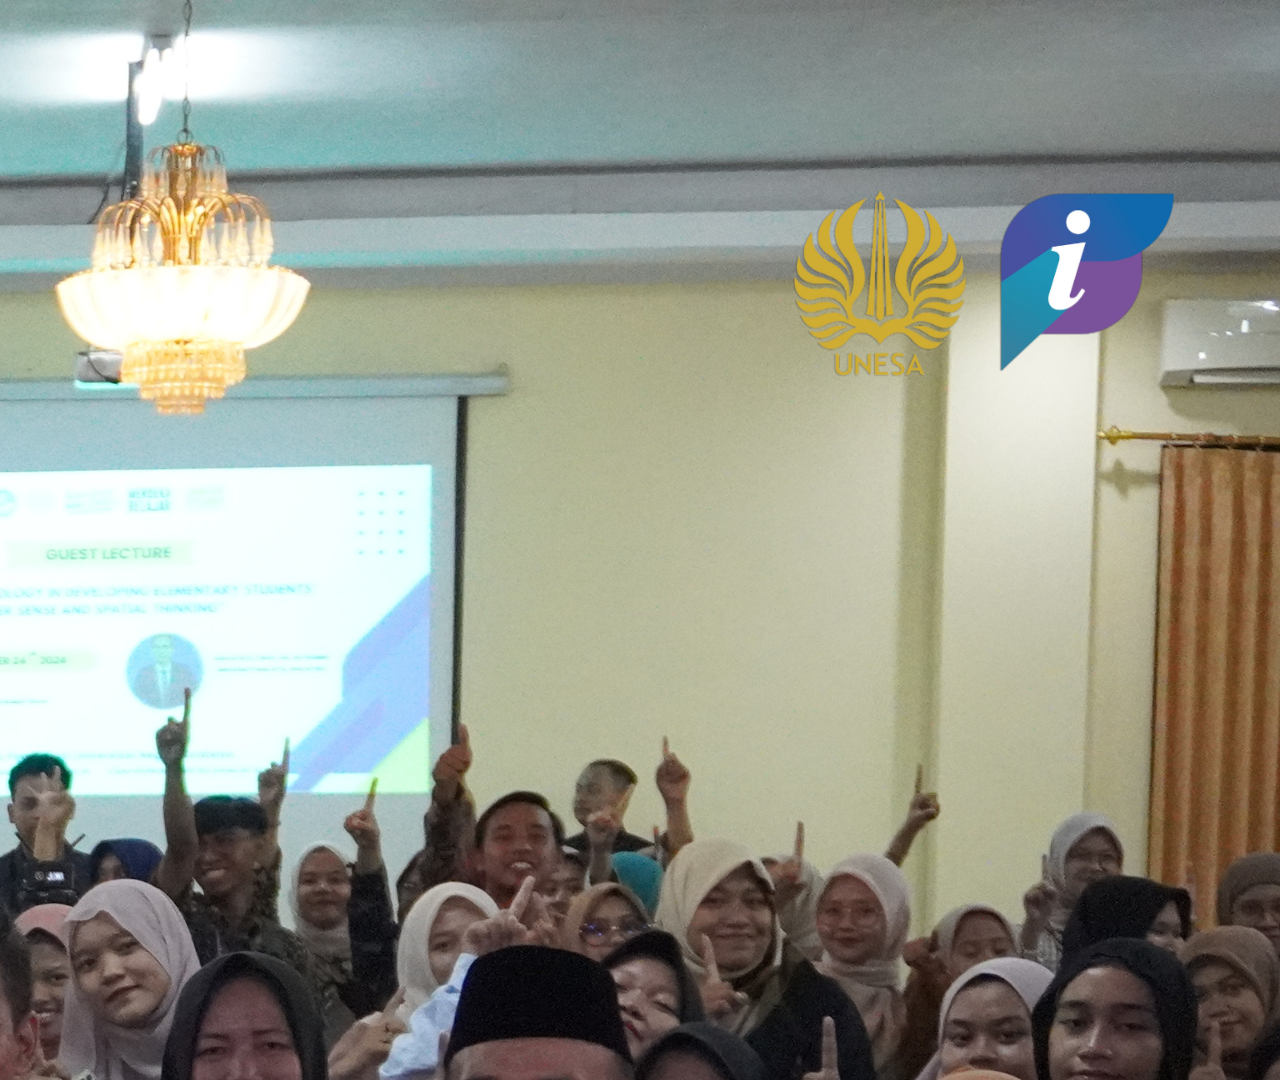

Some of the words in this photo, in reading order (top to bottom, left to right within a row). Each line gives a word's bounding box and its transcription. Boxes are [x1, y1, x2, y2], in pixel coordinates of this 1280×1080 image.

[46, 548, 98, 560] GUEST
[102, 547, 172, 560] LECTURE
[66, 585, 148, 598] DEVELOPING
[153, 584, 238, 596] ELEMENTARY
[17, 605, 56, 616] SENSE
[62, 604, 90, 615] AND
[95, 603, 147, 614] SPATIAL
